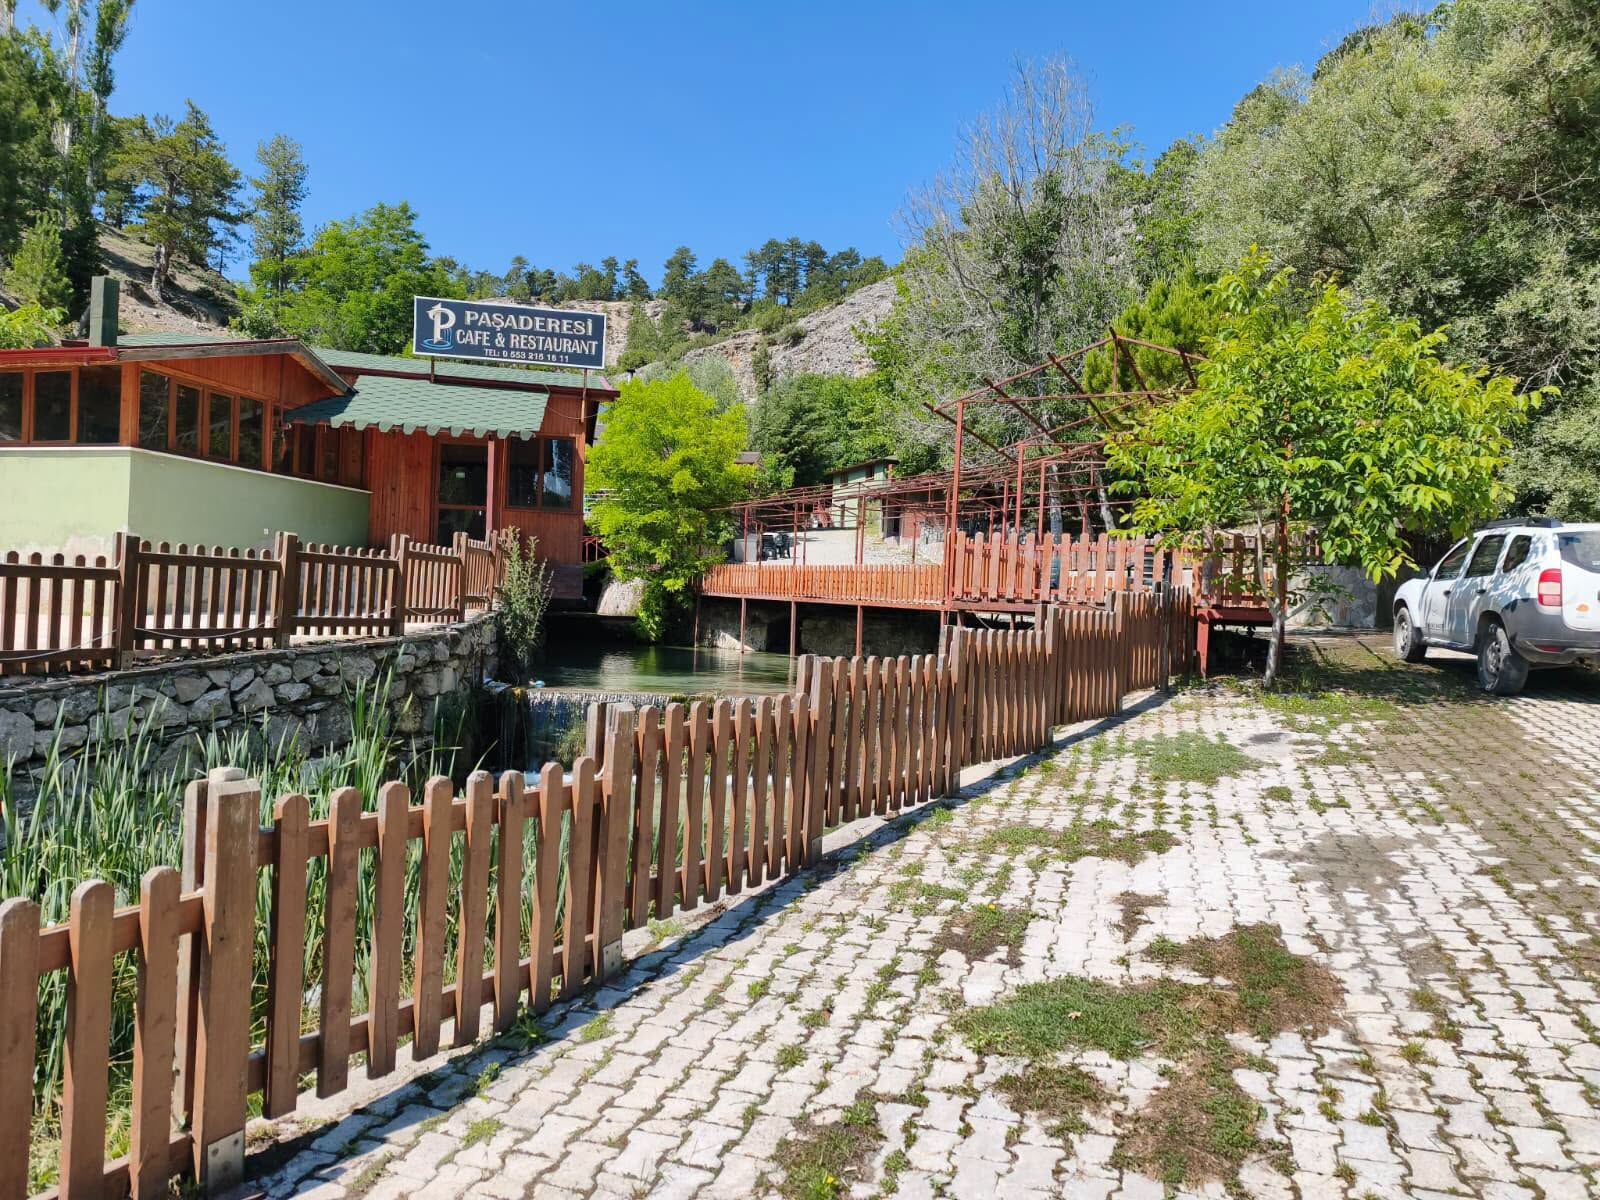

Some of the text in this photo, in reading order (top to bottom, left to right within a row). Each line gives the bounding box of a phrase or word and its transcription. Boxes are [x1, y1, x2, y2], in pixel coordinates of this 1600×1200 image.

[464, 310, 593, 336] PAŞADERESİ
[456, 329, 598, 355] CAFE & RESTAURANT
